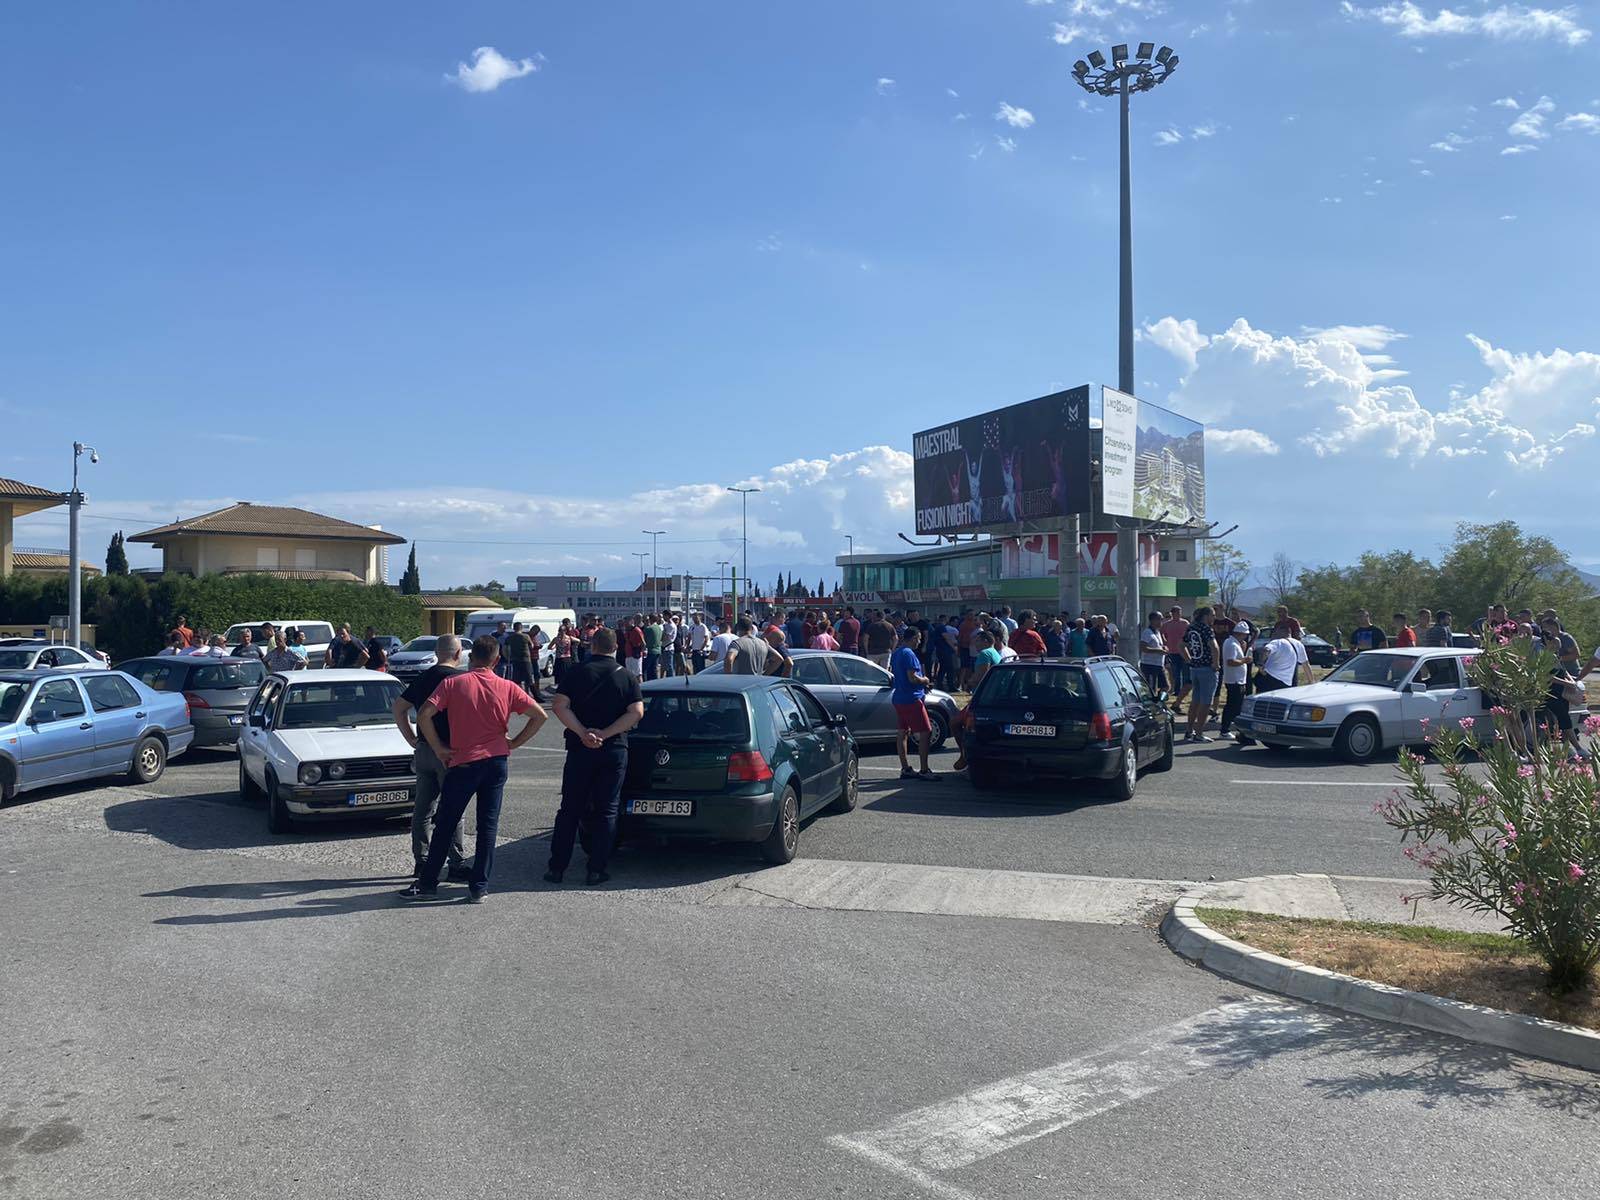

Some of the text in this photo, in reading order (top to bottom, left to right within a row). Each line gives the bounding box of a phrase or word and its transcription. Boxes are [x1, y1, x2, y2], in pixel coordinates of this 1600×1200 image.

[915, 427, 962, 460] MAESTRAL
[917, 506, 946, 531] FUSION
[853, 592, 875, 602] VOLI
[356, 791, 408, 804] PG GB063
[633, 801, 690, 814] PG GF163
